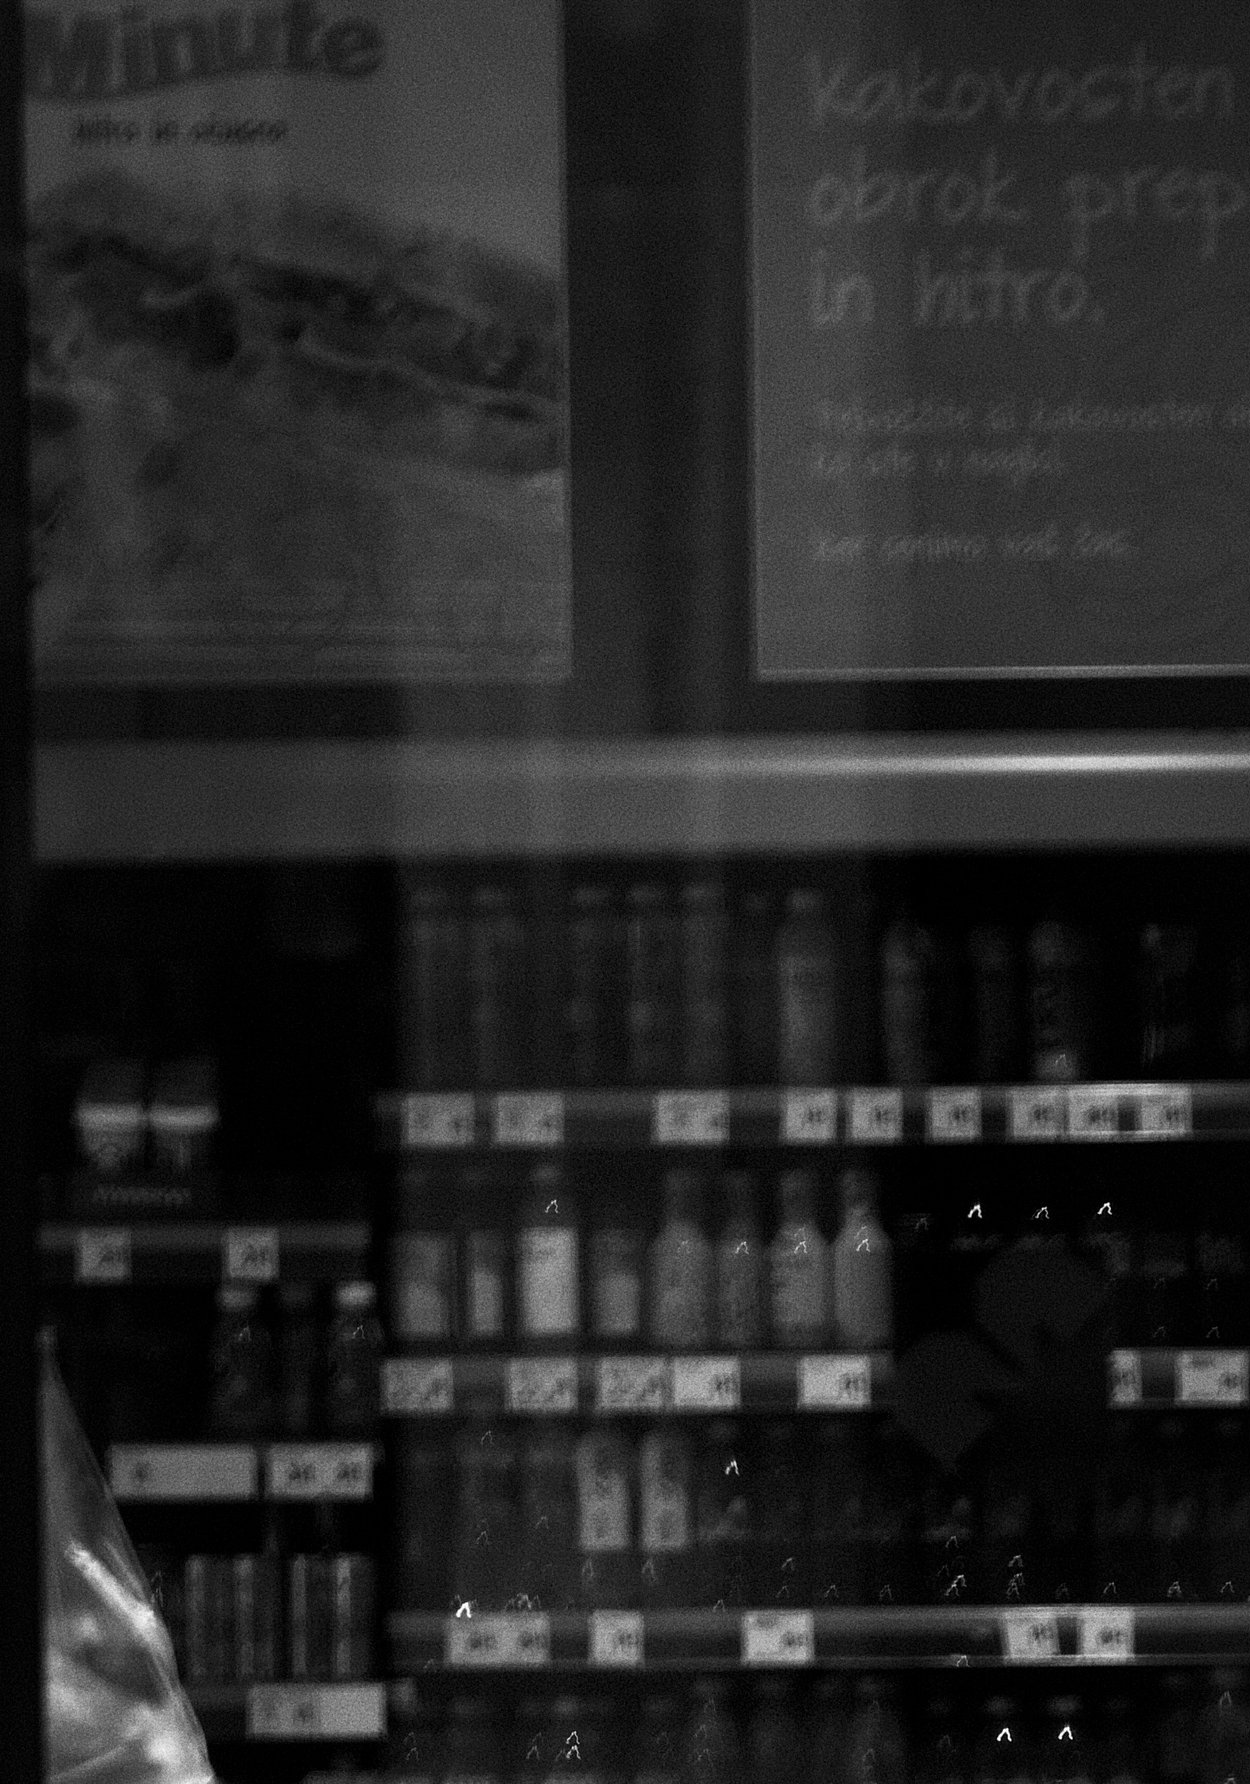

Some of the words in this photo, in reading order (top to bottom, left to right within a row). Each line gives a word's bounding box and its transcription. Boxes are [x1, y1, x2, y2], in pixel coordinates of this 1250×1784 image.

[24, 0, 386, 98] Minute
[803, 41, 1236, 129] Kakovosten
[805, 145, 1030, 226] obrok
[808, 247, 877, 330] in
[914, 245, 1107, 330] hitro.
